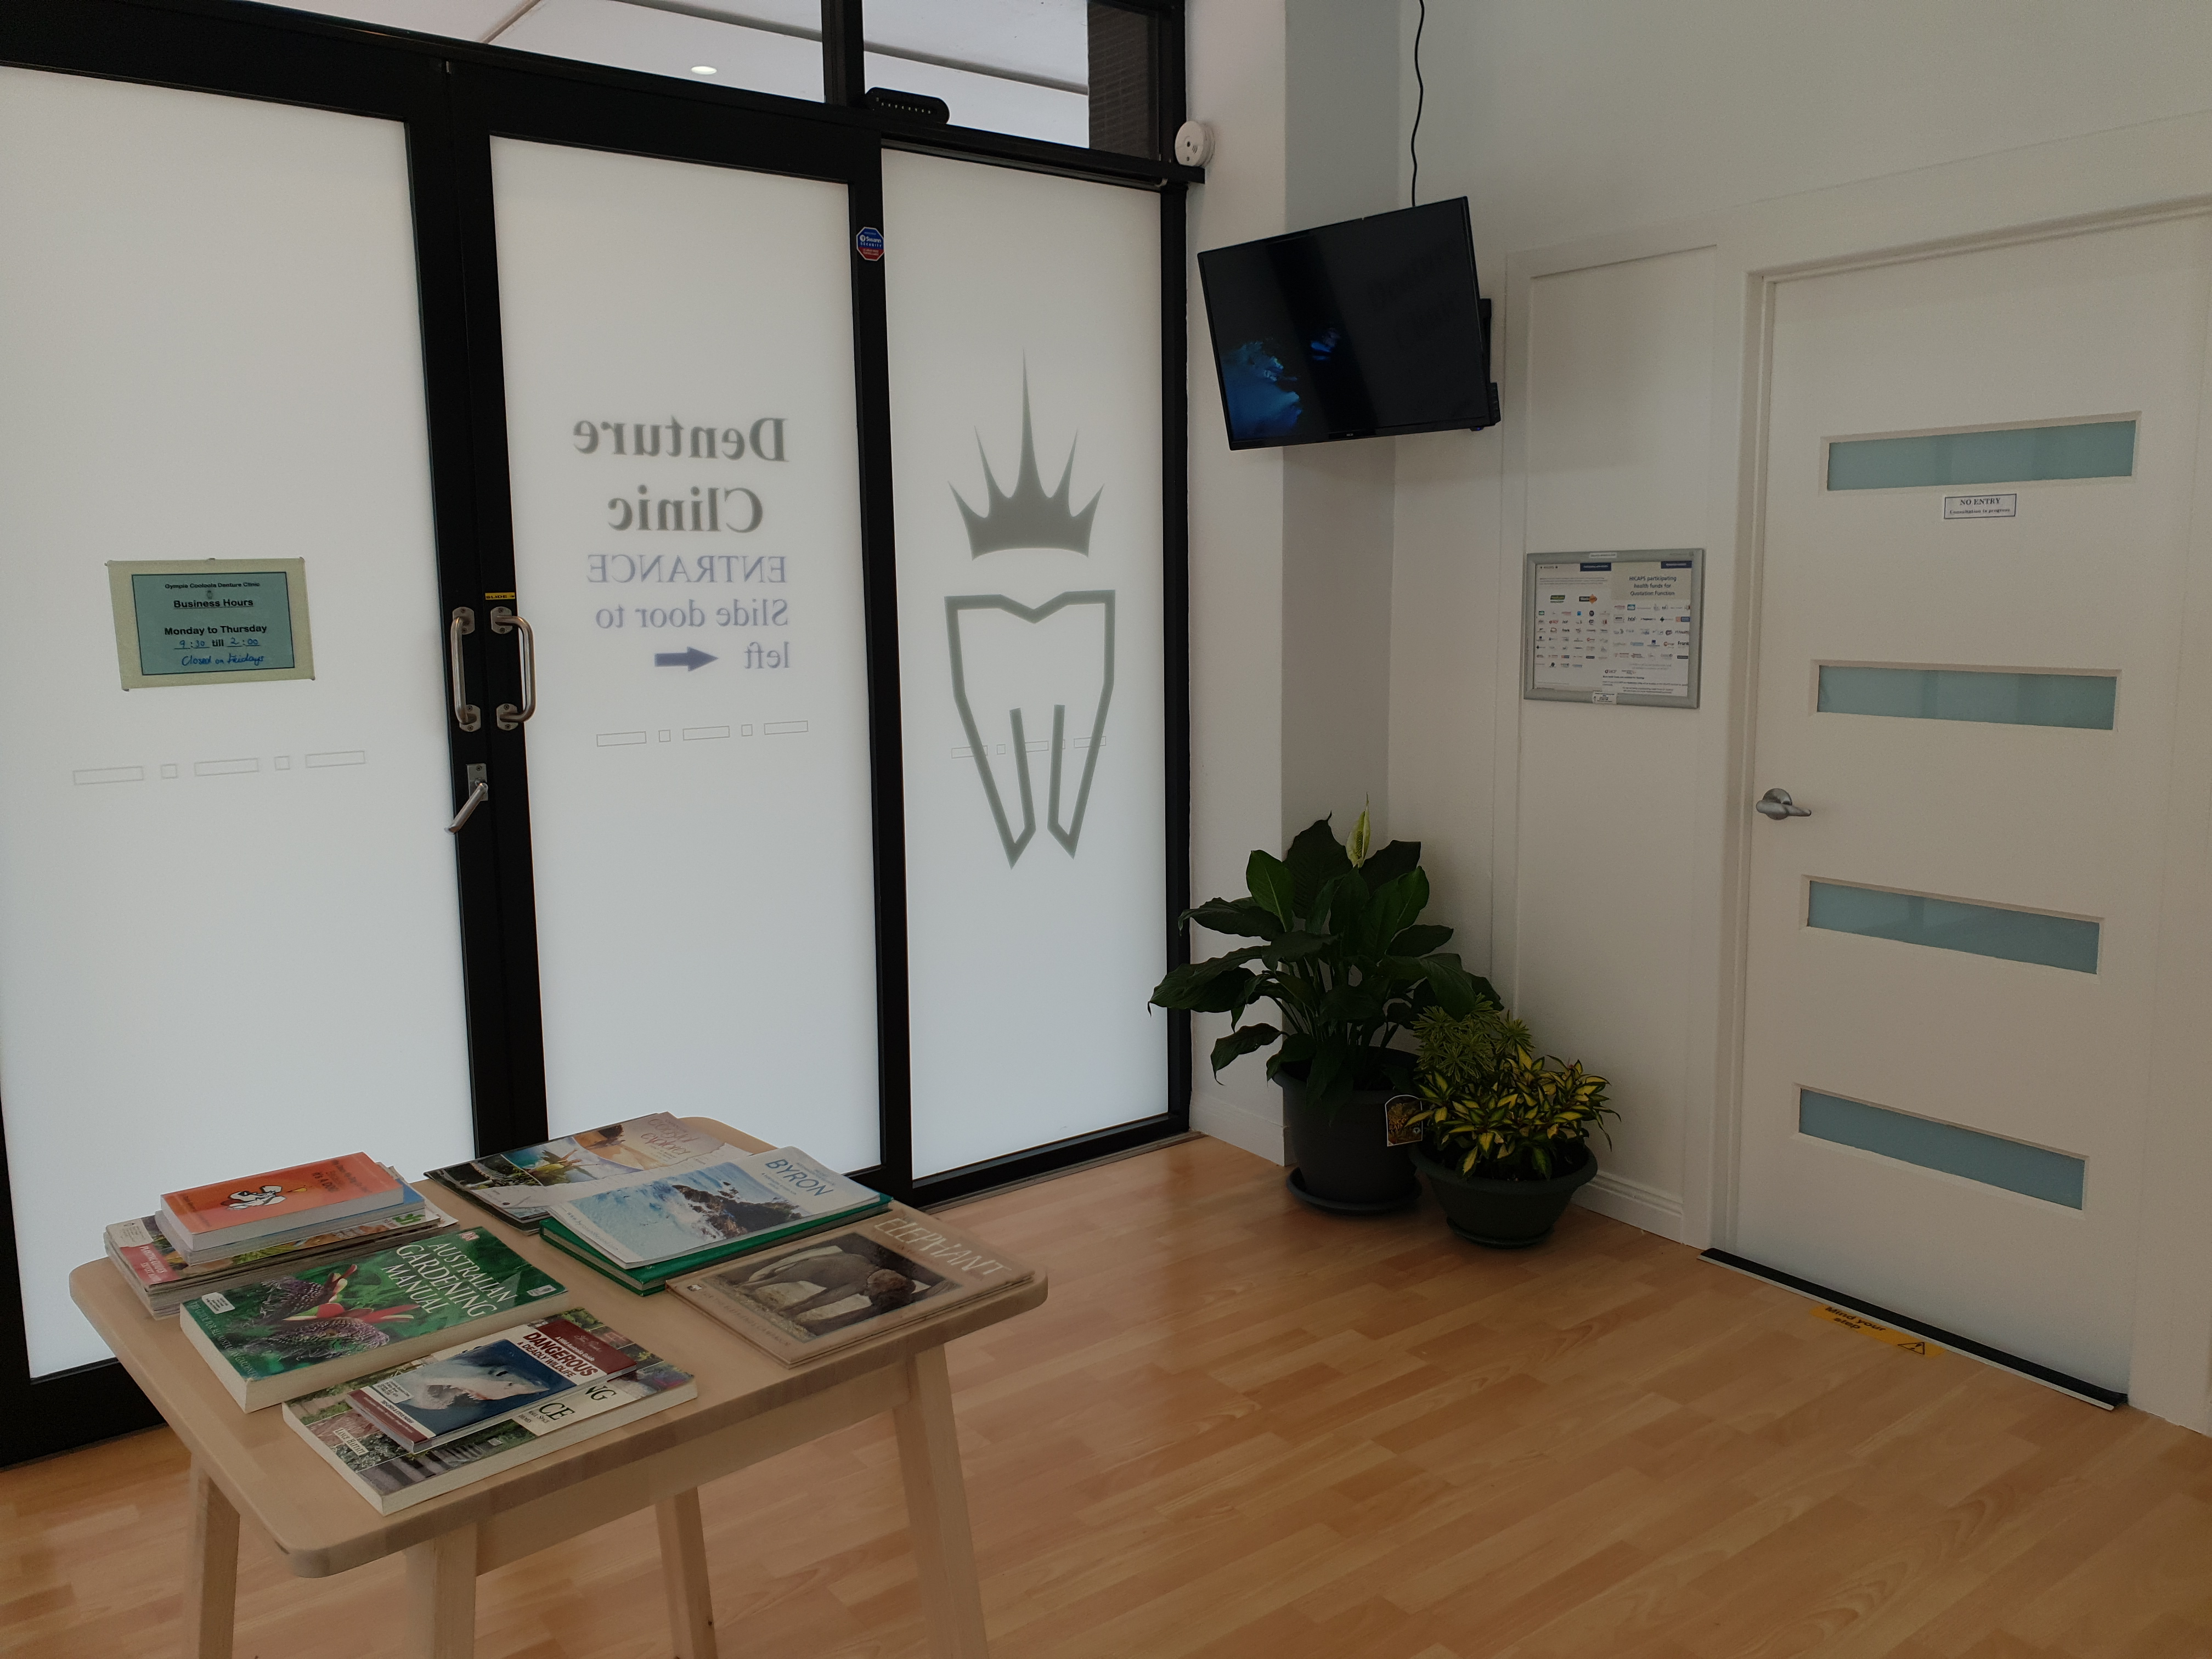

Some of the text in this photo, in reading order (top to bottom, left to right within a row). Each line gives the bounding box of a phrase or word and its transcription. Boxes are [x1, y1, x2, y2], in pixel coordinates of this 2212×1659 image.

[173, 599, 253, 608] Business Hours
[165, 624, 267, 636] Monday to Thursday
[212, 639, 224, 647] till
[182, 653, 212, 665] Closed
[765, 1159, 834, 1196] BYRON
[874, 1218, 1012, 1276] ELEPHANT
[396, 1244, 497, 1317] GARDENING
[428, 1243, 517, 1302] AUSTRALIAN
[381, 1264, 450, 1313] MANUAL
[1825, 1307, 1886, 1331] Mind your
[1833, 1317, 1860, 1329] step
[522, 1344, 549, 1360] DEADLY
[545, 1359, 577, 1378] WILDLIFE
[523, 1332, 599, 1376] DANGEROUS
[539, 1402, 575, 1421] CE
